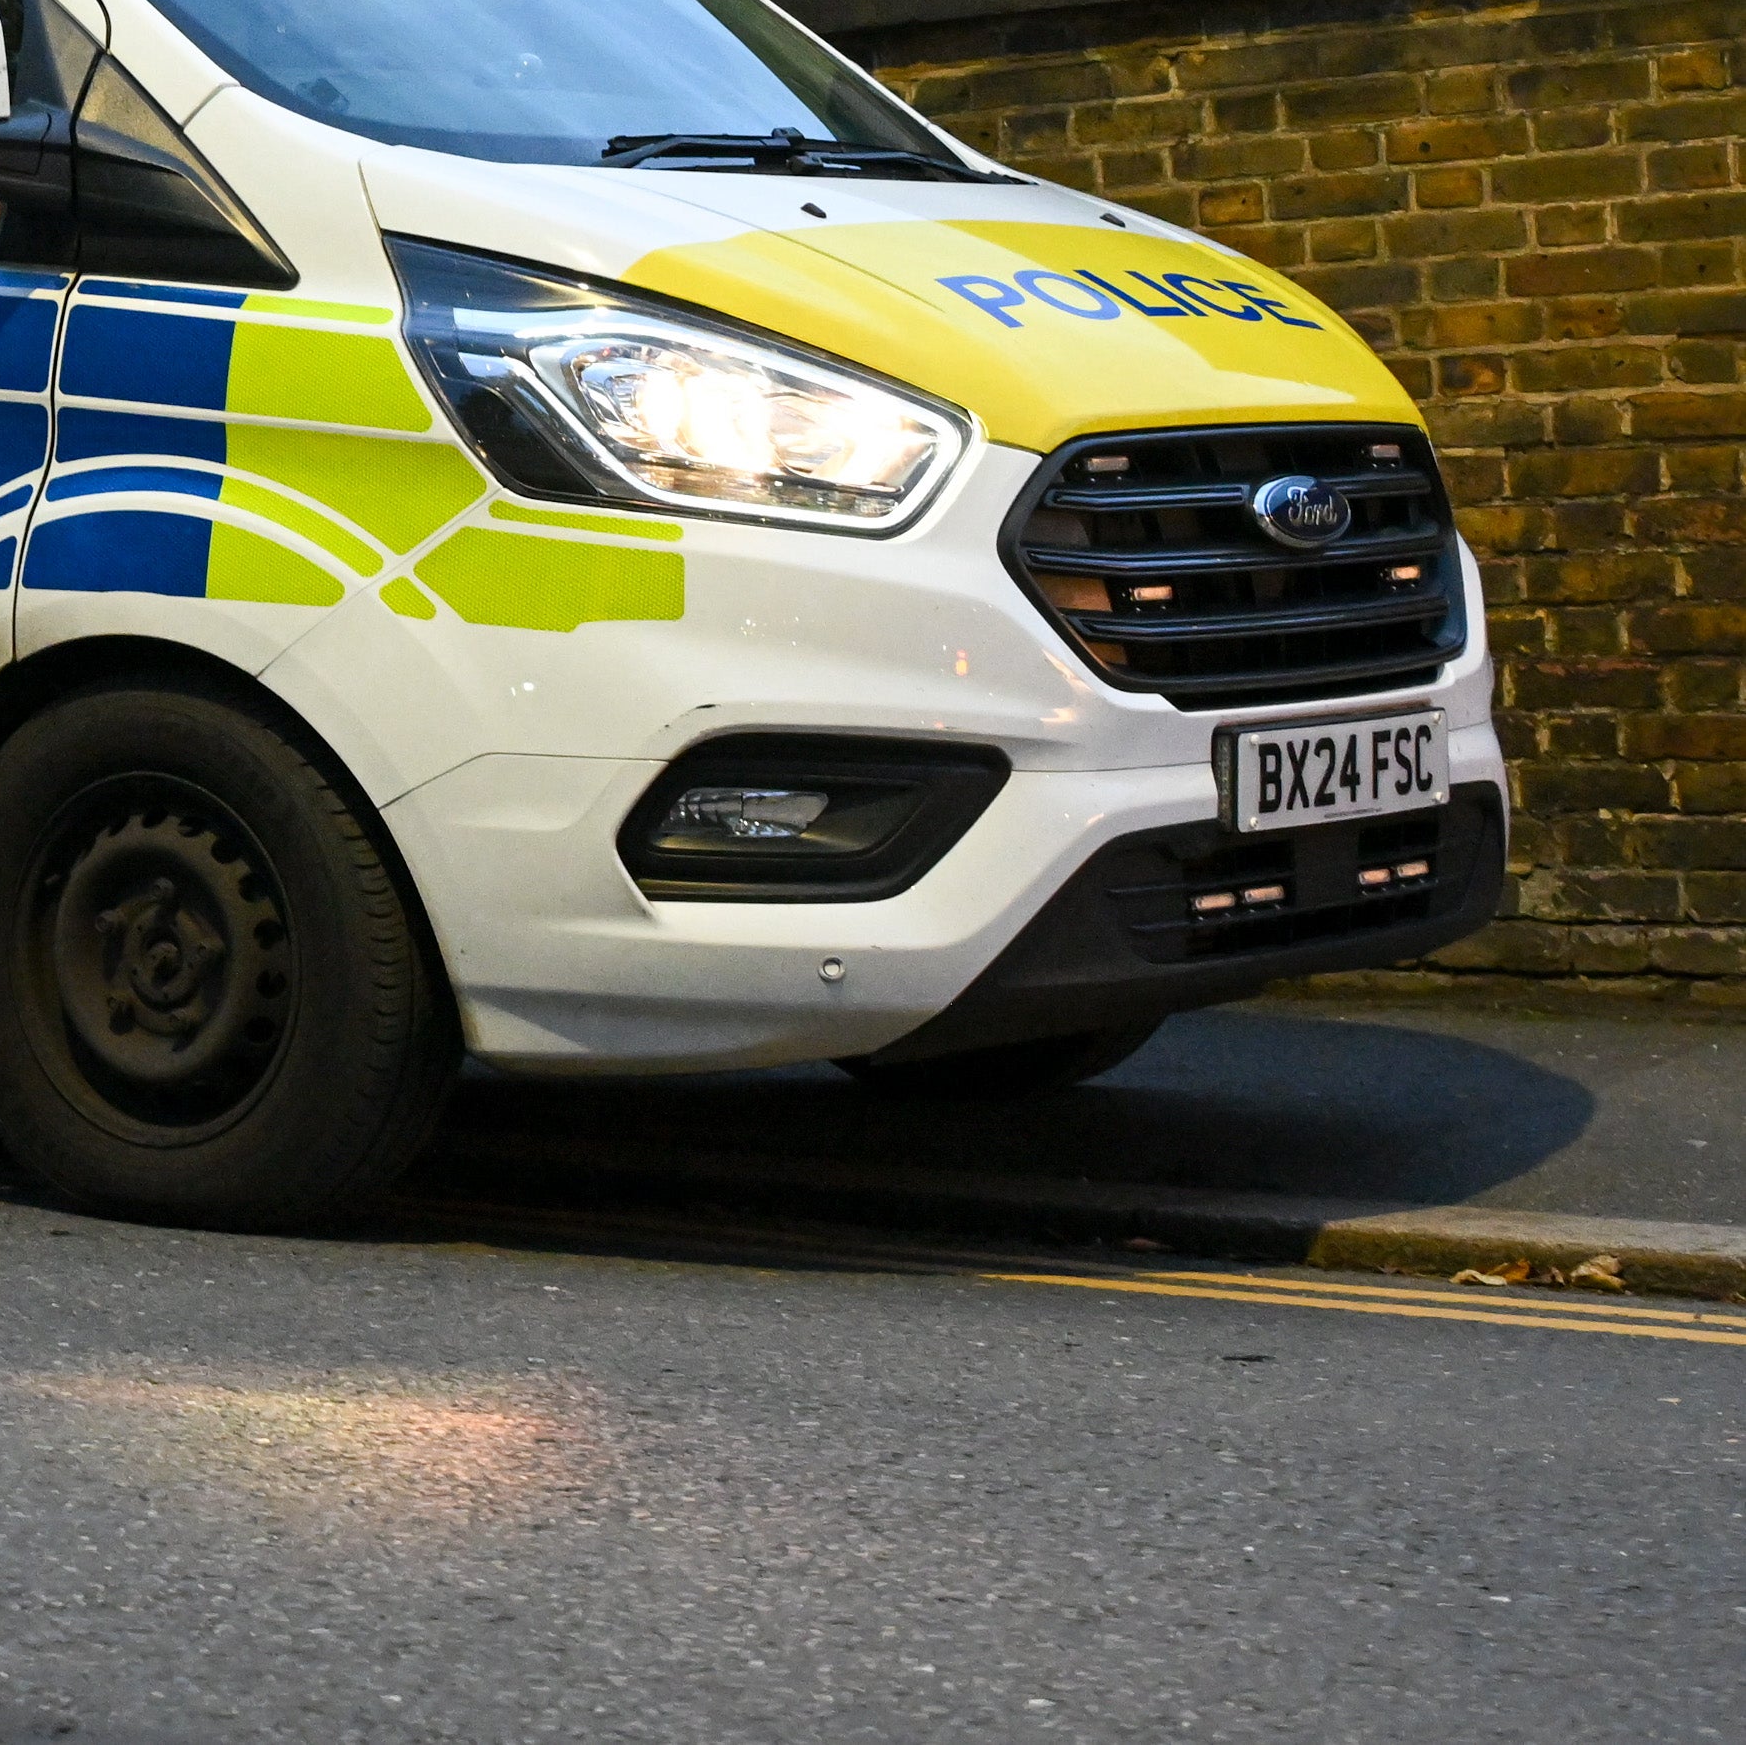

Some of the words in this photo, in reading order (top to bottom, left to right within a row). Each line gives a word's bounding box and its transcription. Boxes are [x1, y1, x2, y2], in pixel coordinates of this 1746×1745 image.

[934, 269, 1325, 330] POLICE
[1287, 485, 1338, 526] Ford
[1258, 733, 1361, 813] BX24
[1372, 724, 1433, 800] FSC
